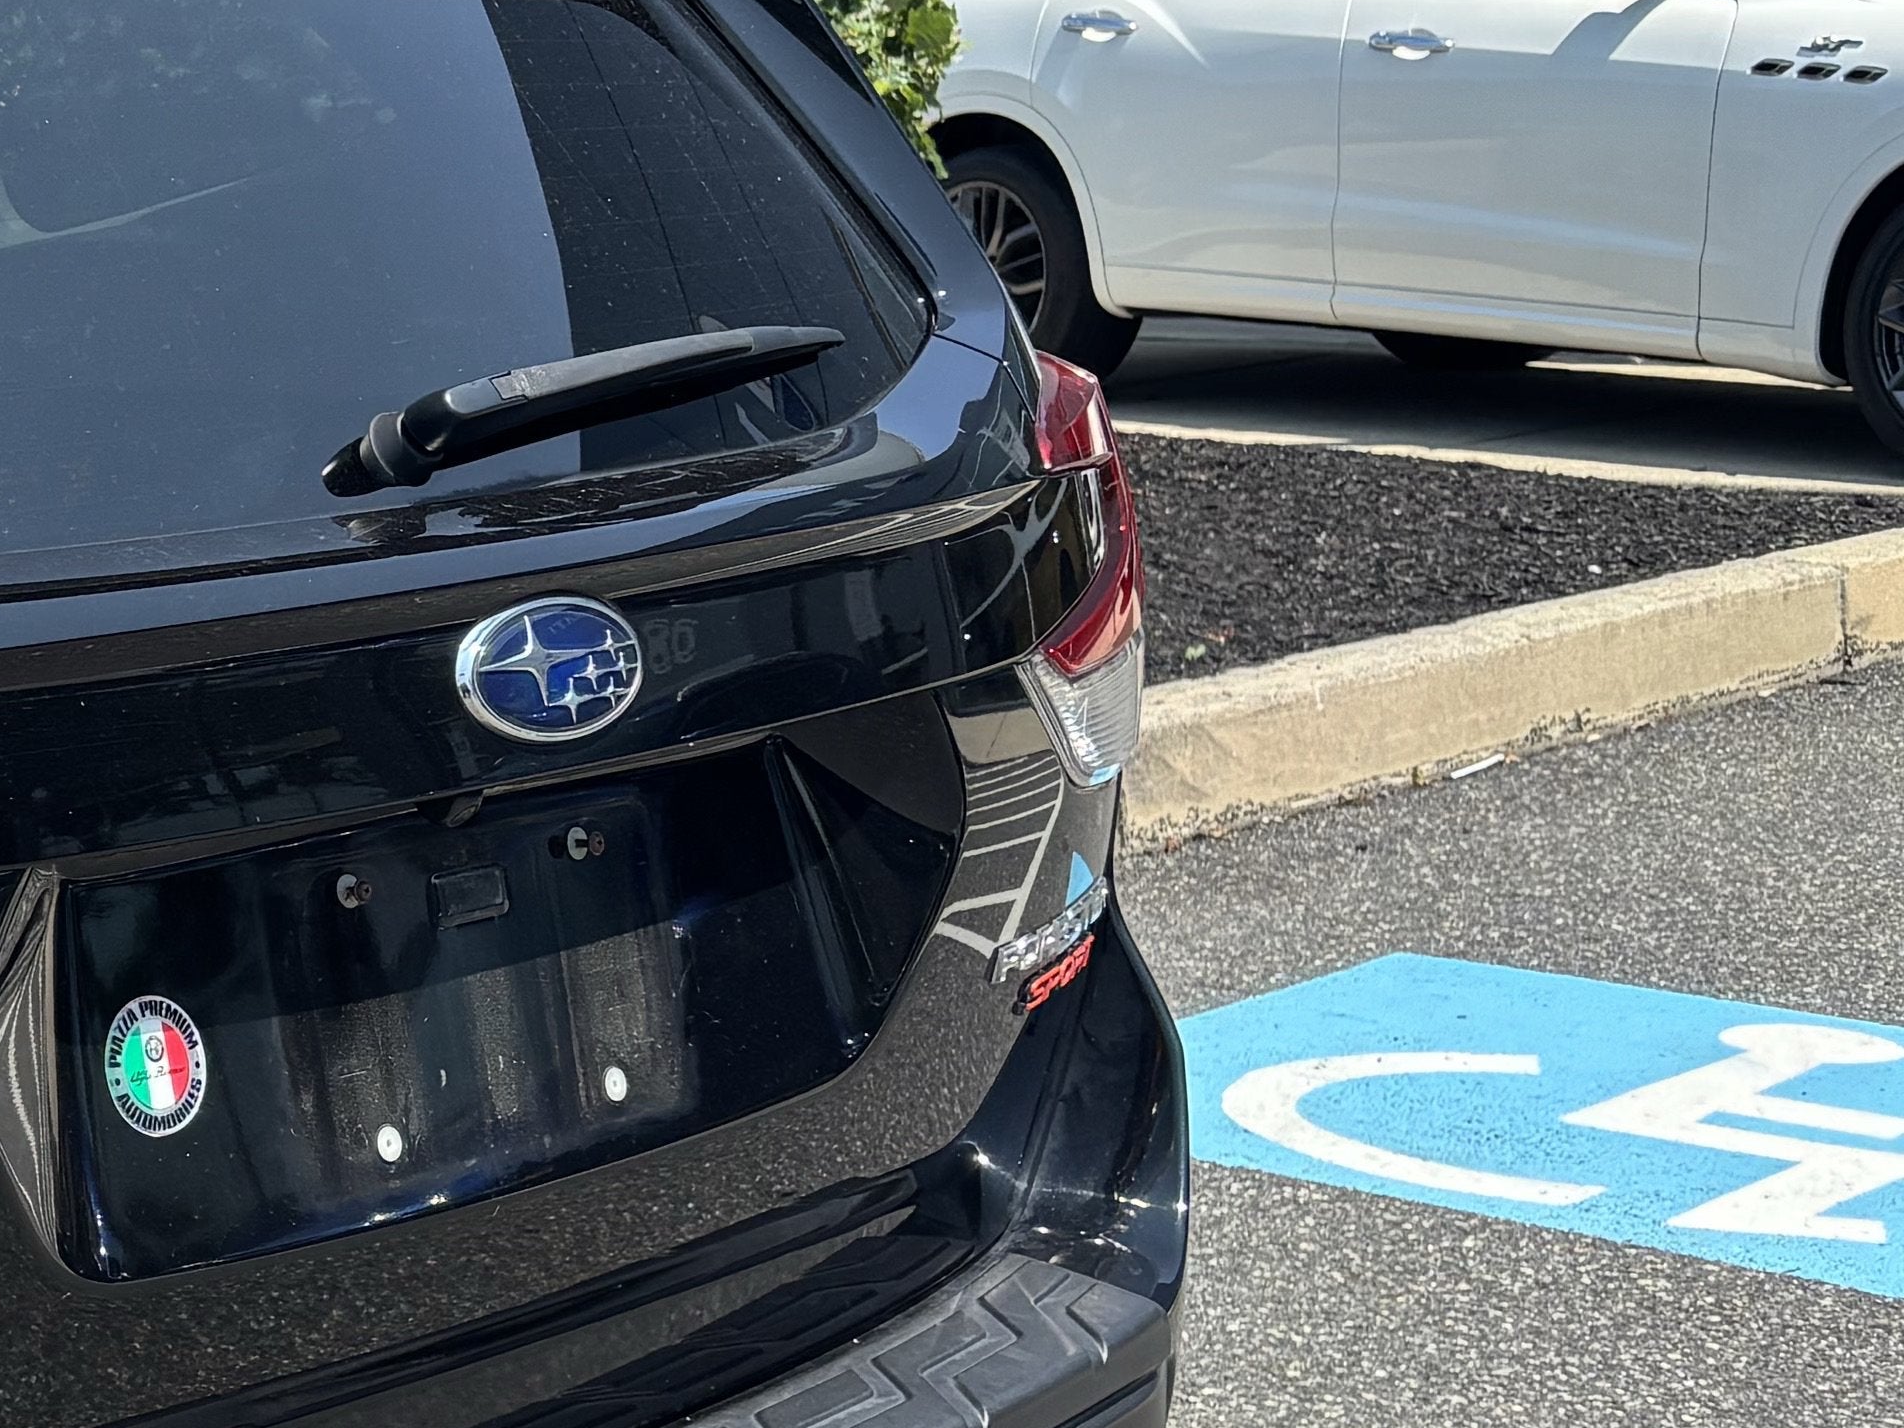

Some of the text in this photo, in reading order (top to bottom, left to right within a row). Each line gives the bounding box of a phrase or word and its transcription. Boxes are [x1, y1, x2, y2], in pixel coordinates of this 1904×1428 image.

[108, 999, 199, 1069] PIAZZA PREMIUM
[117, 1077, 202, 1131] AUTOMOBILES
